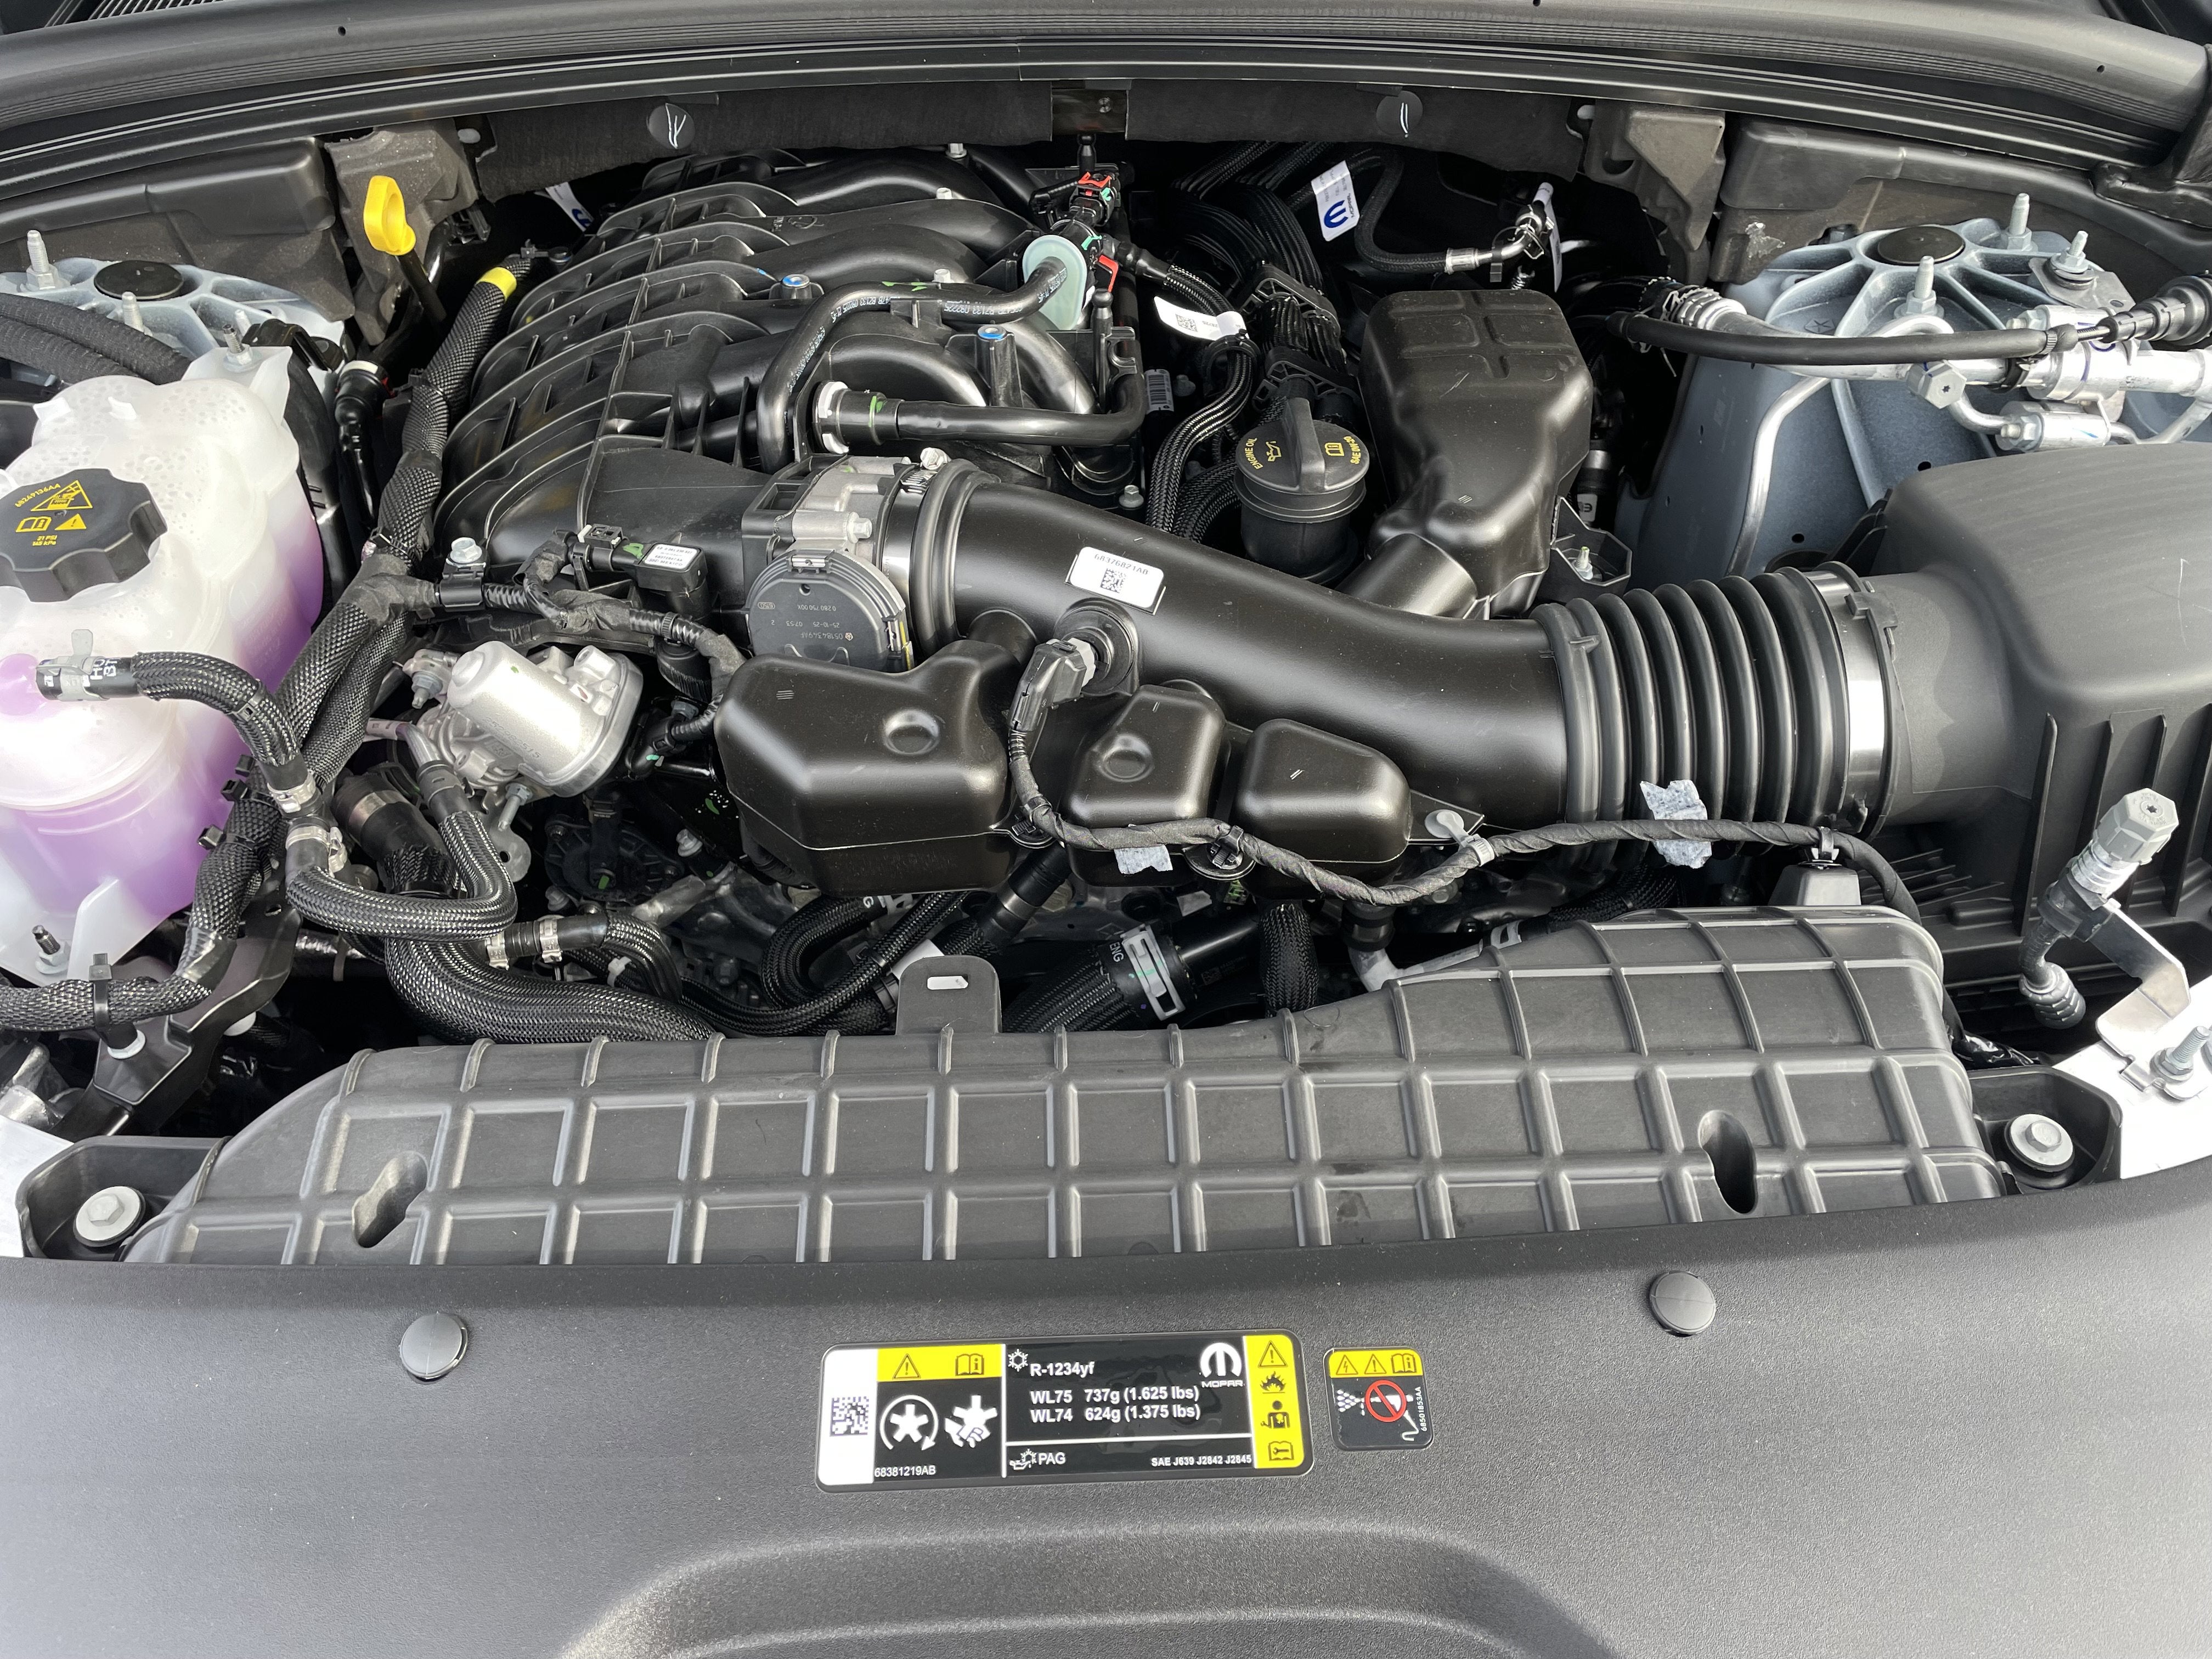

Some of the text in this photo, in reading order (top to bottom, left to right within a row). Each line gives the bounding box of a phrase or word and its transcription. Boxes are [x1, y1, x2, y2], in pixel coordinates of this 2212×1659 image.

[1245, 437, 1263, 470] ENGINE OIL
[1350, 452, 1361, 465] SAE
[1094, 554, 1148, 575] 68376821AB
[1109, 941, 1124, 962] ENG
[1030, 1362, 1095, 1378] R-1234yf
[1201, 1380, 1244, 1388] MOPAR
[1030, 1385, 1199, 1404] WL75 737g (1.625 lbs)
[1030, 1403, 1201, 1423] WL74 624g (1.375 lbs)
[1414, 1386, 1427, 1431] 68501853AA
[1038, 1452, 1066, 1465] PAG
[1151, 1454, 1252, 1467] SAE J639 J2842 J2845
[874, 1465, 936, 1477] 68381219AB
